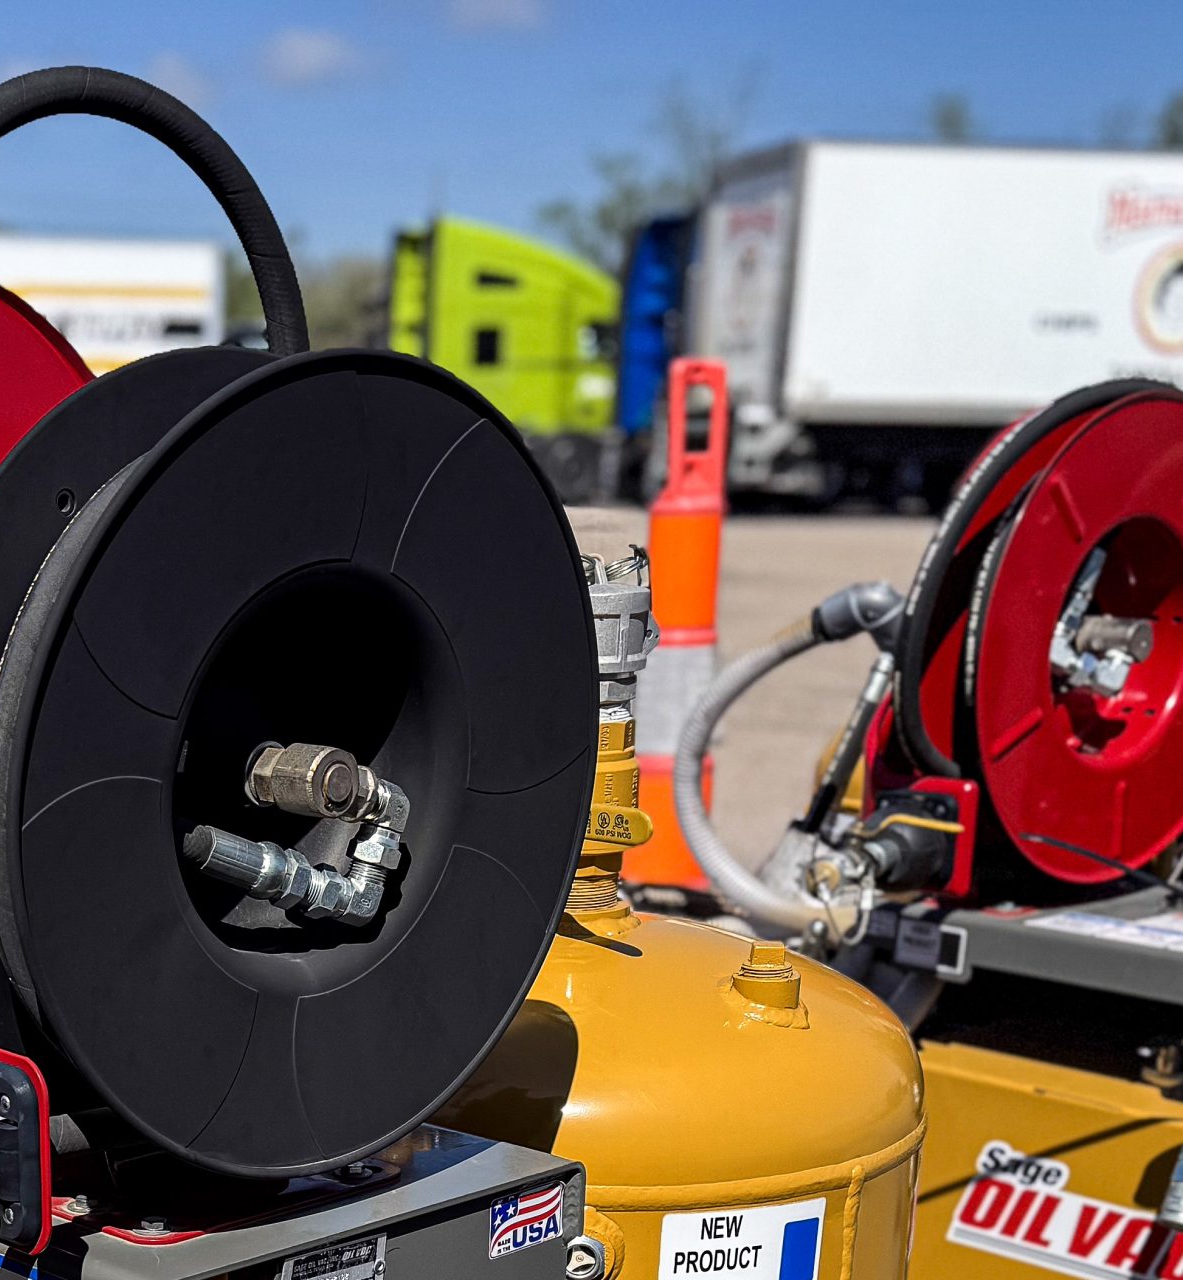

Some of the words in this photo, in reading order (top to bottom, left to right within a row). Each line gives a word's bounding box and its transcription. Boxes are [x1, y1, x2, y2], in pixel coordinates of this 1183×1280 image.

[981, 1147, 1063, 1187] Sage
[700, 1214, 744, 1241] NEW
[958, 1176, 1063, 1248] OIL
[512, 1213, 559, 1249] USA
[673, 1244, 763, 1275] PRODUCT
